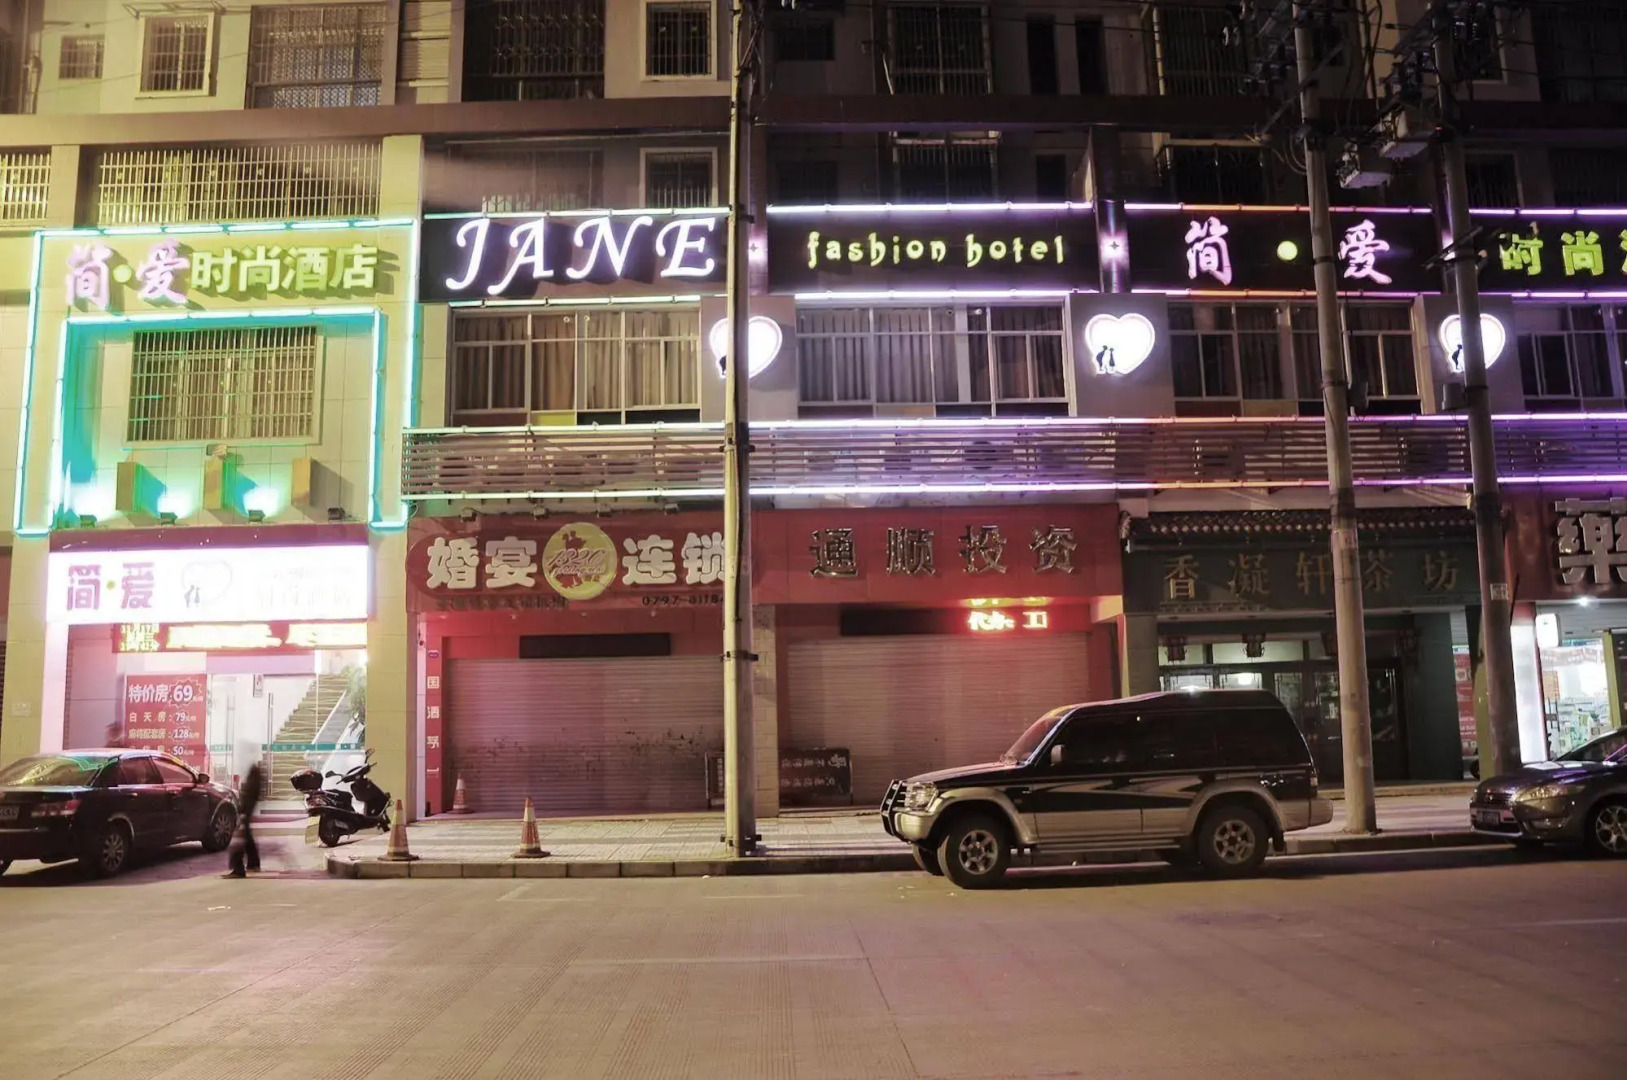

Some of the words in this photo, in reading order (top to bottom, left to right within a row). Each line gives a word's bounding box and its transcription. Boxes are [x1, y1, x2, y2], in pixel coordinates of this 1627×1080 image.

[190, 244, 379, 293] 时尚酒店
[445, 216, 716, 296] JANE
[806, 231, 948, 269] fashion
[965, 233, 1066, 269] hotel
[1498, 230, 1627, 276] 时尚
[426, 536, 538, 589] 婚宴
[622, 532, 725, 585] 连锁
[808, 526, 1078, 578] 通顺投资
